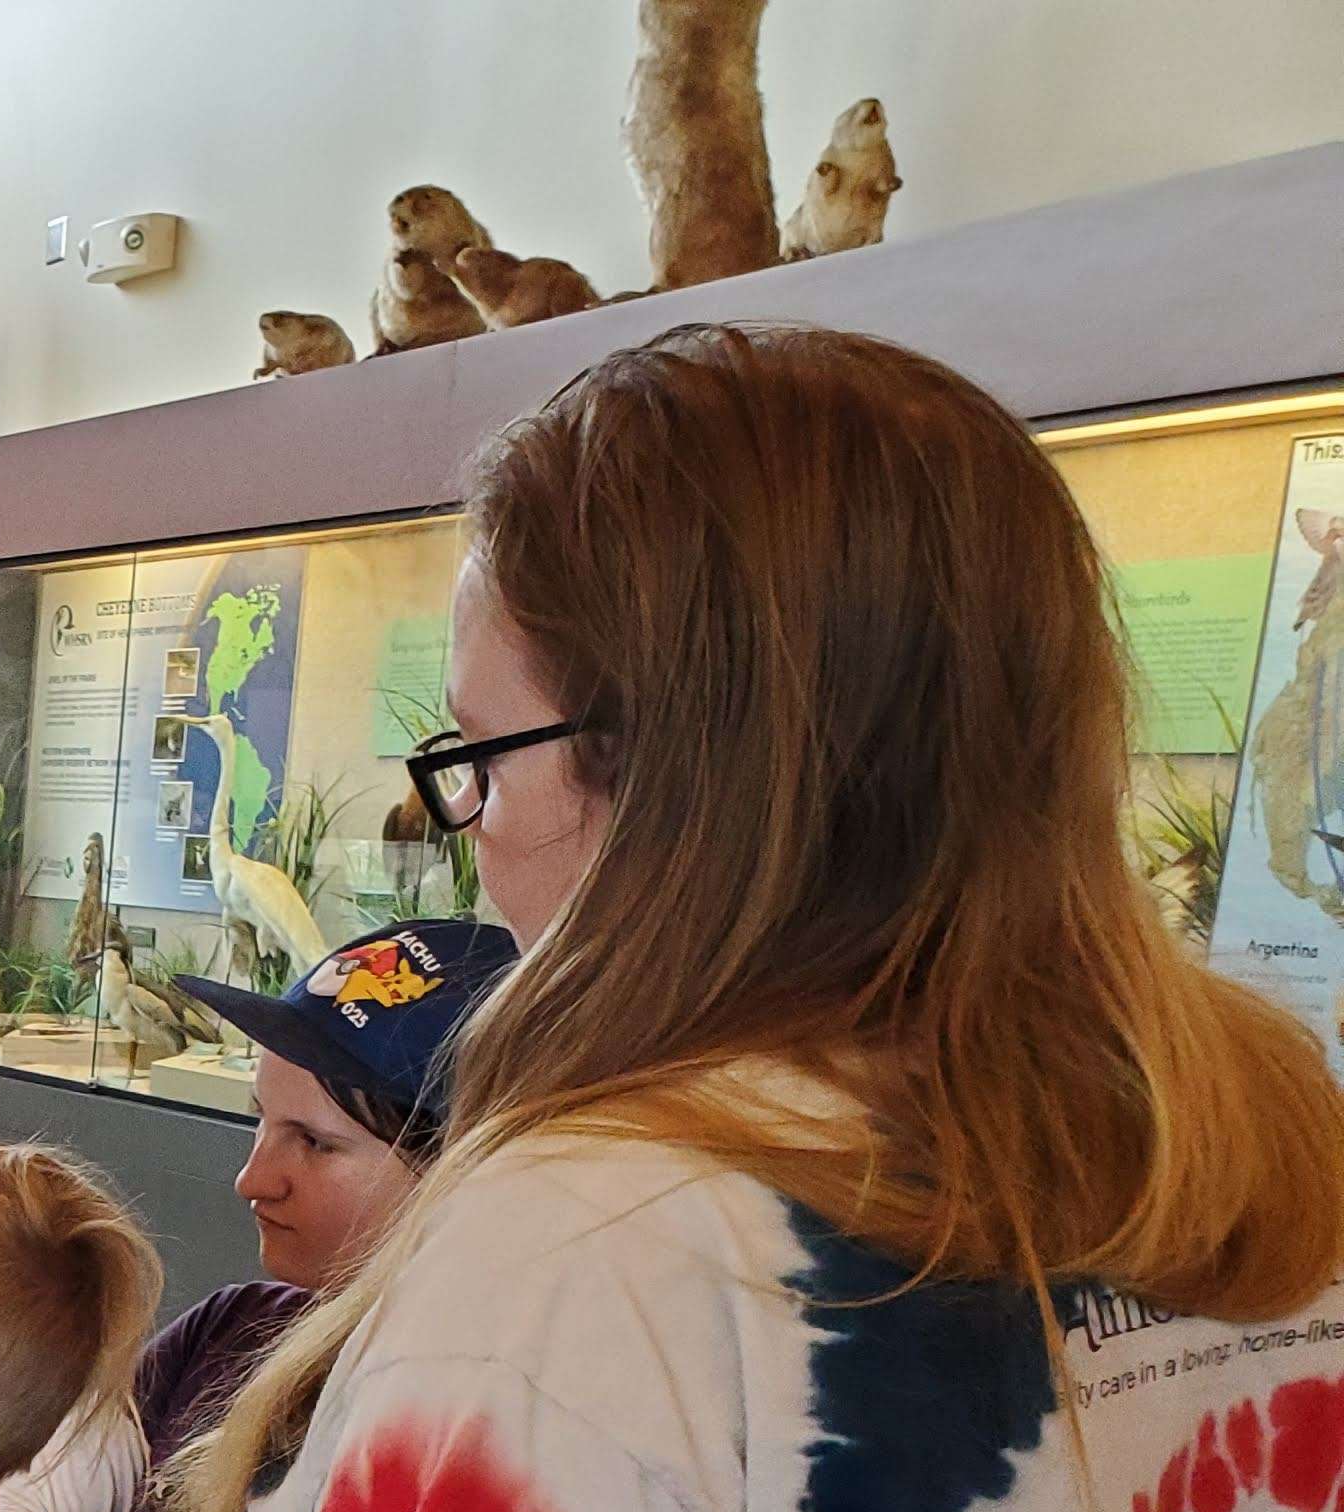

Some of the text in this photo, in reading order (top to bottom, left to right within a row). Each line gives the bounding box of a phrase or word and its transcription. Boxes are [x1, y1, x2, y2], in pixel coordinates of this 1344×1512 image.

[1247, 939, 1319, 961] Argentina
[340, 1002, 369, 1029] 025
[1100, 1369, 1137, 1399] care
[1140, 1361, 1157, 1385] in
[1164, 1359, 1176, 1378] a
[1181, 1343, 1231, 1373] loving
